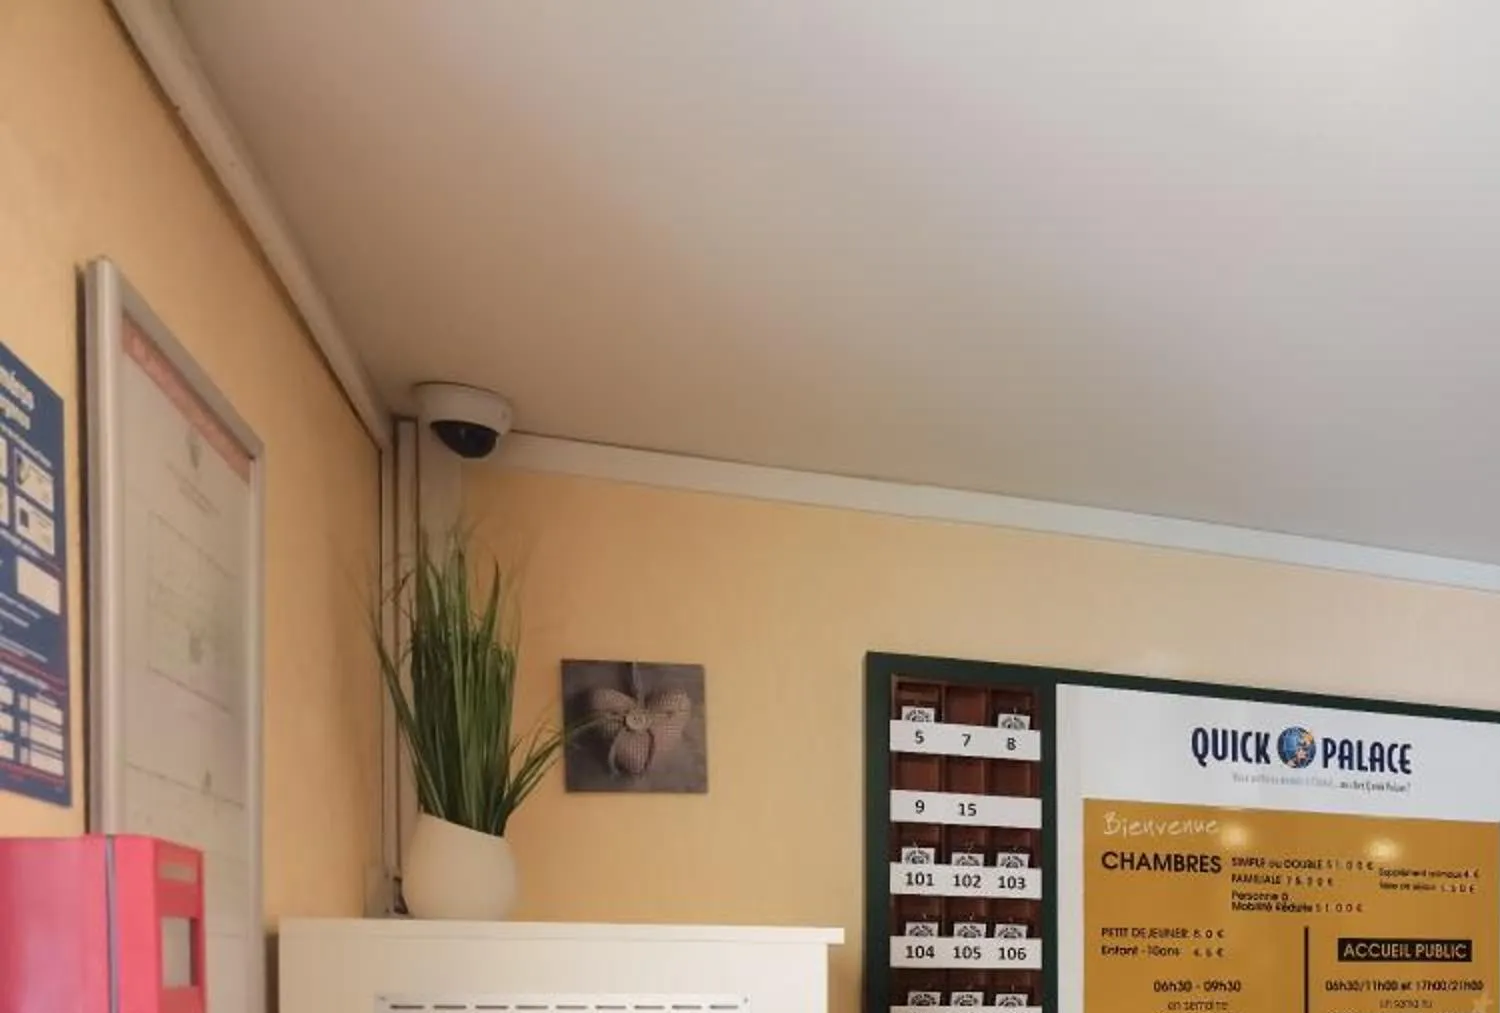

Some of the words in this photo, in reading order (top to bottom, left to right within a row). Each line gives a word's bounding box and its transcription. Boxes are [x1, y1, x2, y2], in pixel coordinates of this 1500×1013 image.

[914, 730, 925, 744] 5
[961, 733, 972, 748] 7
[1006, 737, 1017, 751] 8
[1191, 727, 1271, 767] QUICK
[1321, 737, 1412, 776] PALACE
[915, 799, 925, 814] 9
[958, 803, 978, 817] 15
[1102, 811, 1220, 838] Bienvenue
[1101, 851, 1222, 874] CHAMBRES
[905, 872, 935, 886] 101
[953, 874, 982, 889] 102
[998, 875, 1027, 890] 103
[1101, 927, 1128, 938] PETIT
[905, 945, 935, 959] 104
[953, 946, 982, 960] 105
[998, 947, 1027, 961] 106
[1101, 945, 1138, 957] Enfant
[1343, 943, 1411, 959] ACCUEIL
[1415, 943, 1467, 959] PUBLIC
[1153, 980, 1193, 992] 06h30
[1203, 980, 1242, 992] 09h30
